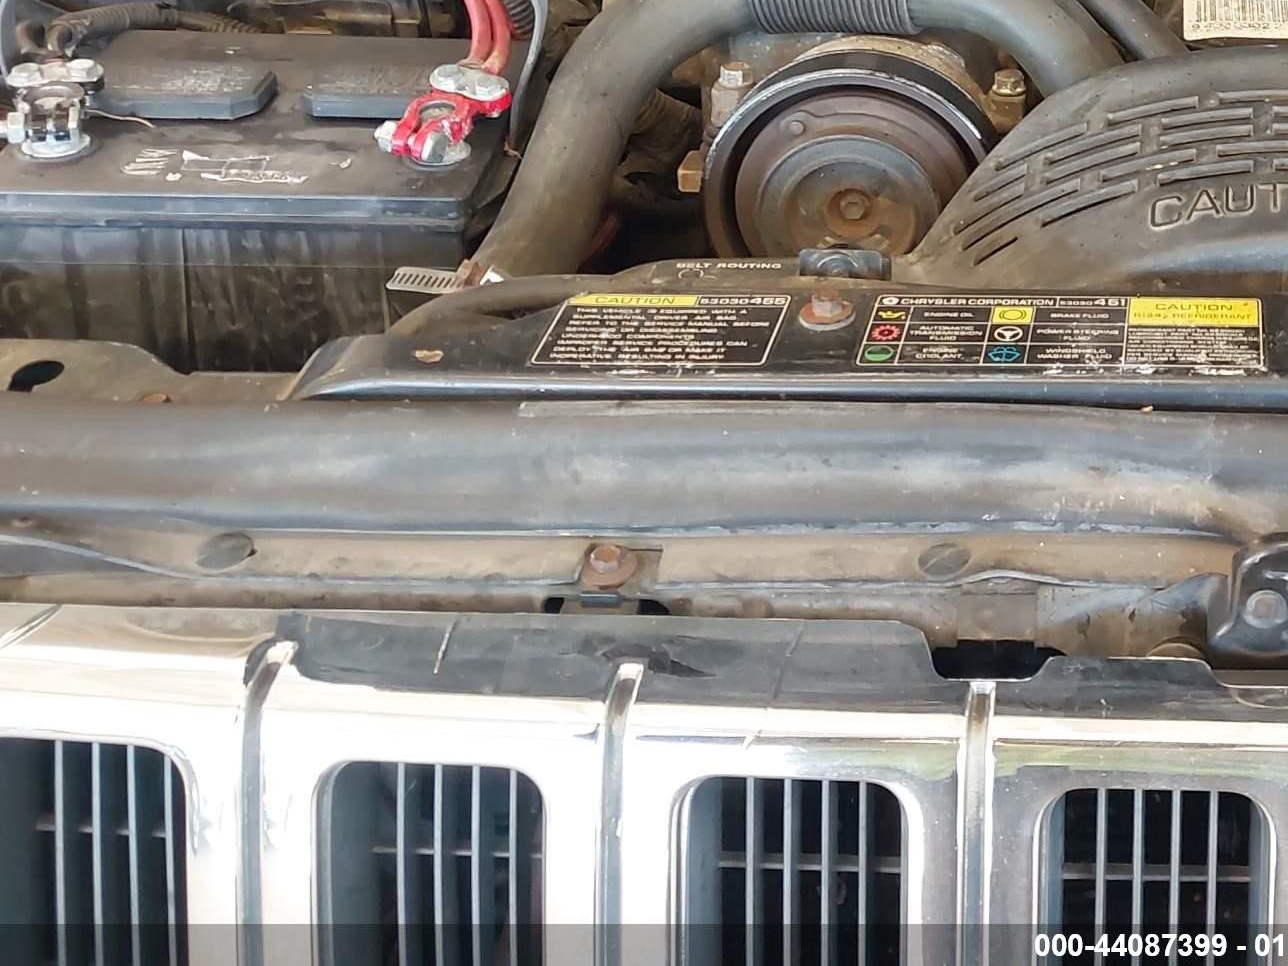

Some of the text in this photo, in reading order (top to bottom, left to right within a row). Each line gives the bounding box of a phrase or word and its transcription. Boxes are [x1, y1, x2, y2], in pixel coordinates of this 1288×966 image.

[595, 296, 675, 304] CAUTION
[968, 298, 1054, 306] CORPORATION
[1155, 303, 1233, 311] CAUTION
